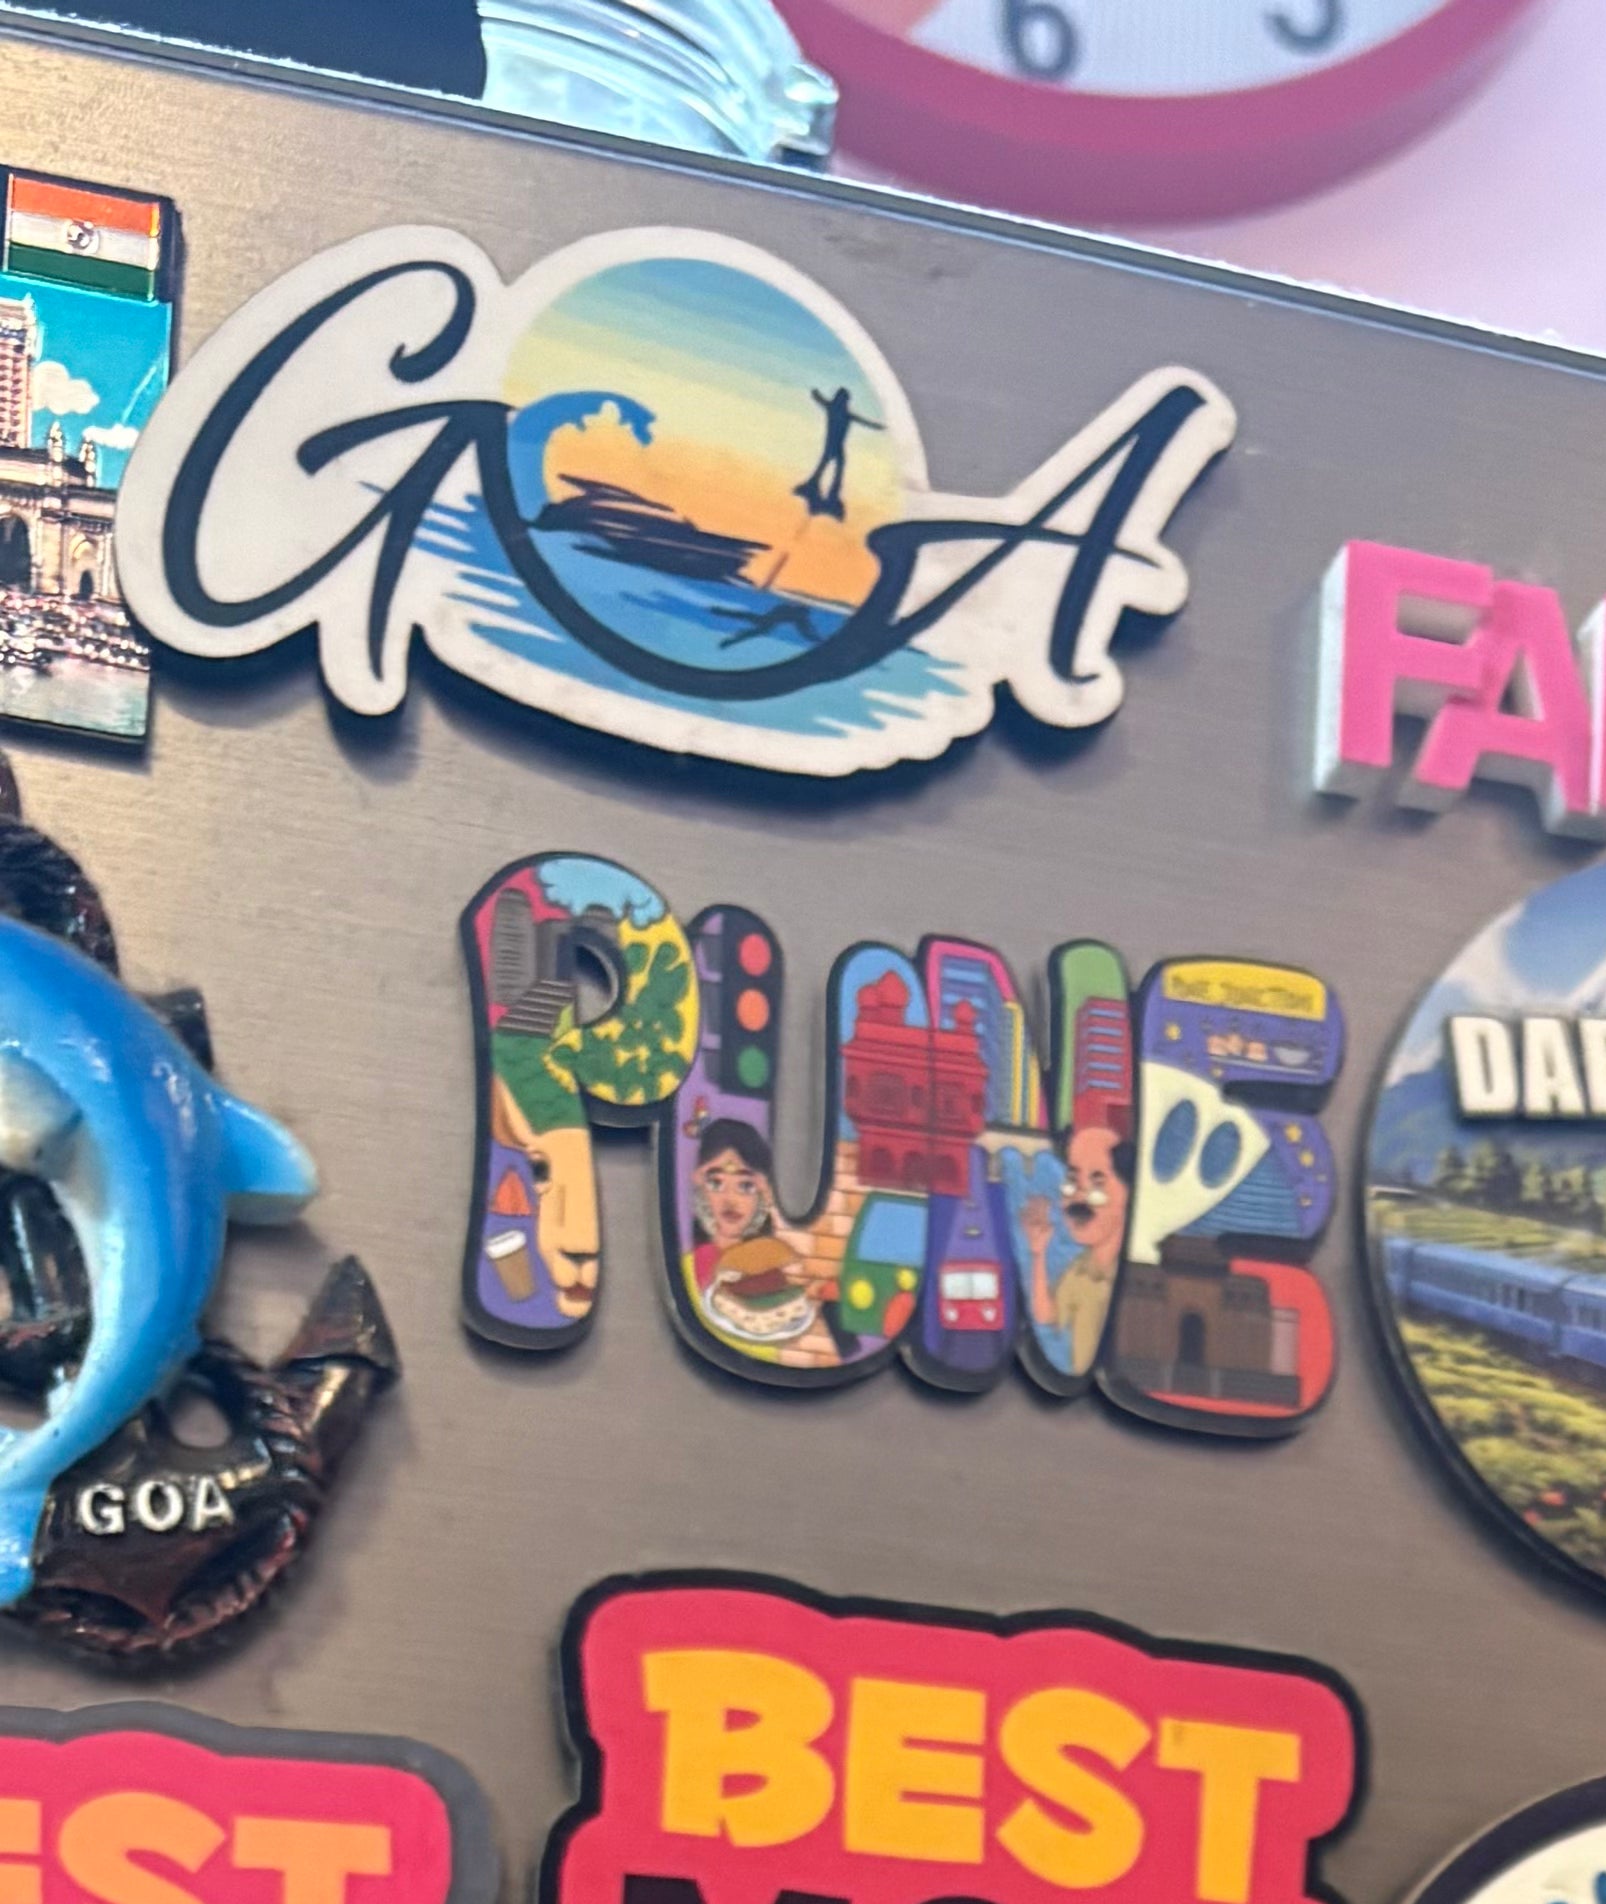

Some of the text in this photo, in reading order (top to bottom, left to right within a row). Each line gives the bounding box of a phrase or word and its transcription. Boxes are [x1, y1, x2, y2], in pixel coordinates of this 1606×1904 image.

[162, 258, 1210, 704] GOA
[462, 850, 1346, 1440] PUNE
[77, 1476, 236, 1537] GOA
[643, 1648, 1302, 1904] BEST
